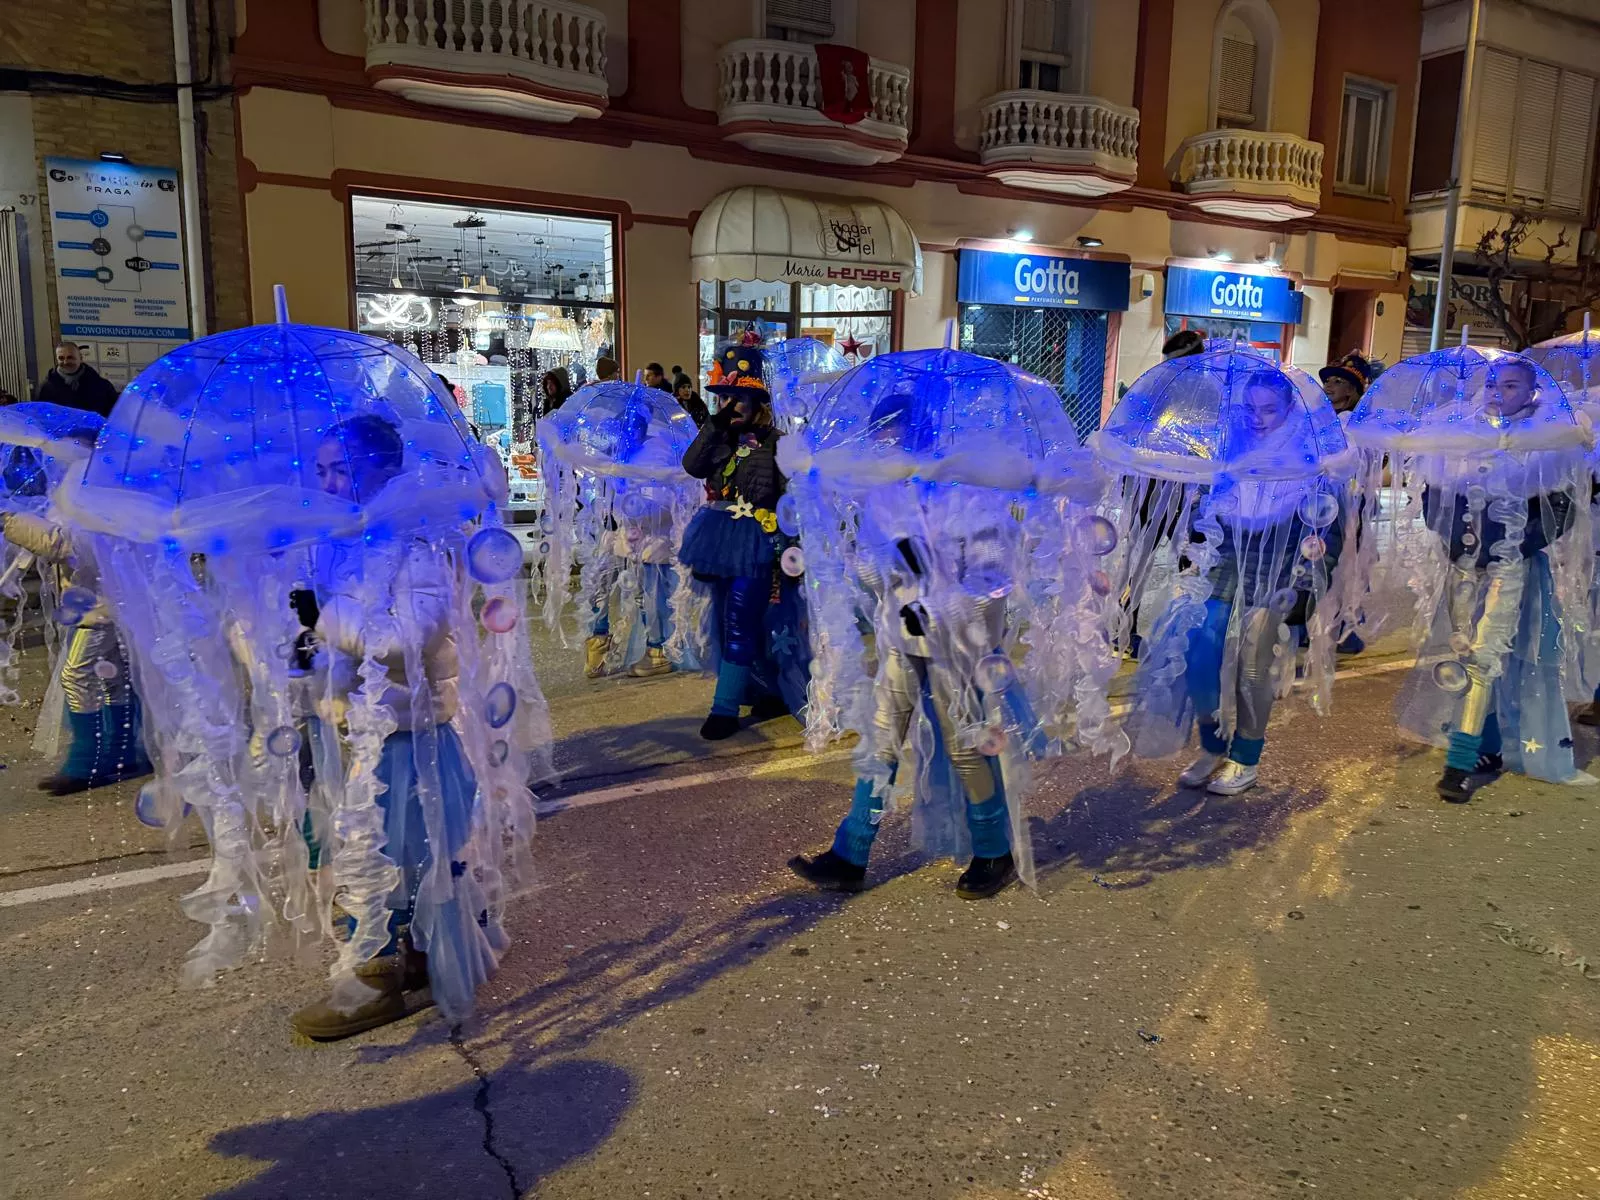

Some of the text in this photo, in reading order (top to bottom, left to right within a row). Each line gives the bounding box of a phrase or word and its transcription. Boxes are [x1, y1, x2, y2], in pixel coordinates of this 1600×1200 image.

[86, 186, 132, 195] FRAGA
[19, 194, 37, 206] 37
[829, 219, 872, 238] Hogar
[780, 260, 825, 278] María
[1014, 257, 1080, 296] Gotta
[1211, 274, 1264, 309] Gotta
[75, 326, 175, 338] COWORKINGFRAGA.COM
